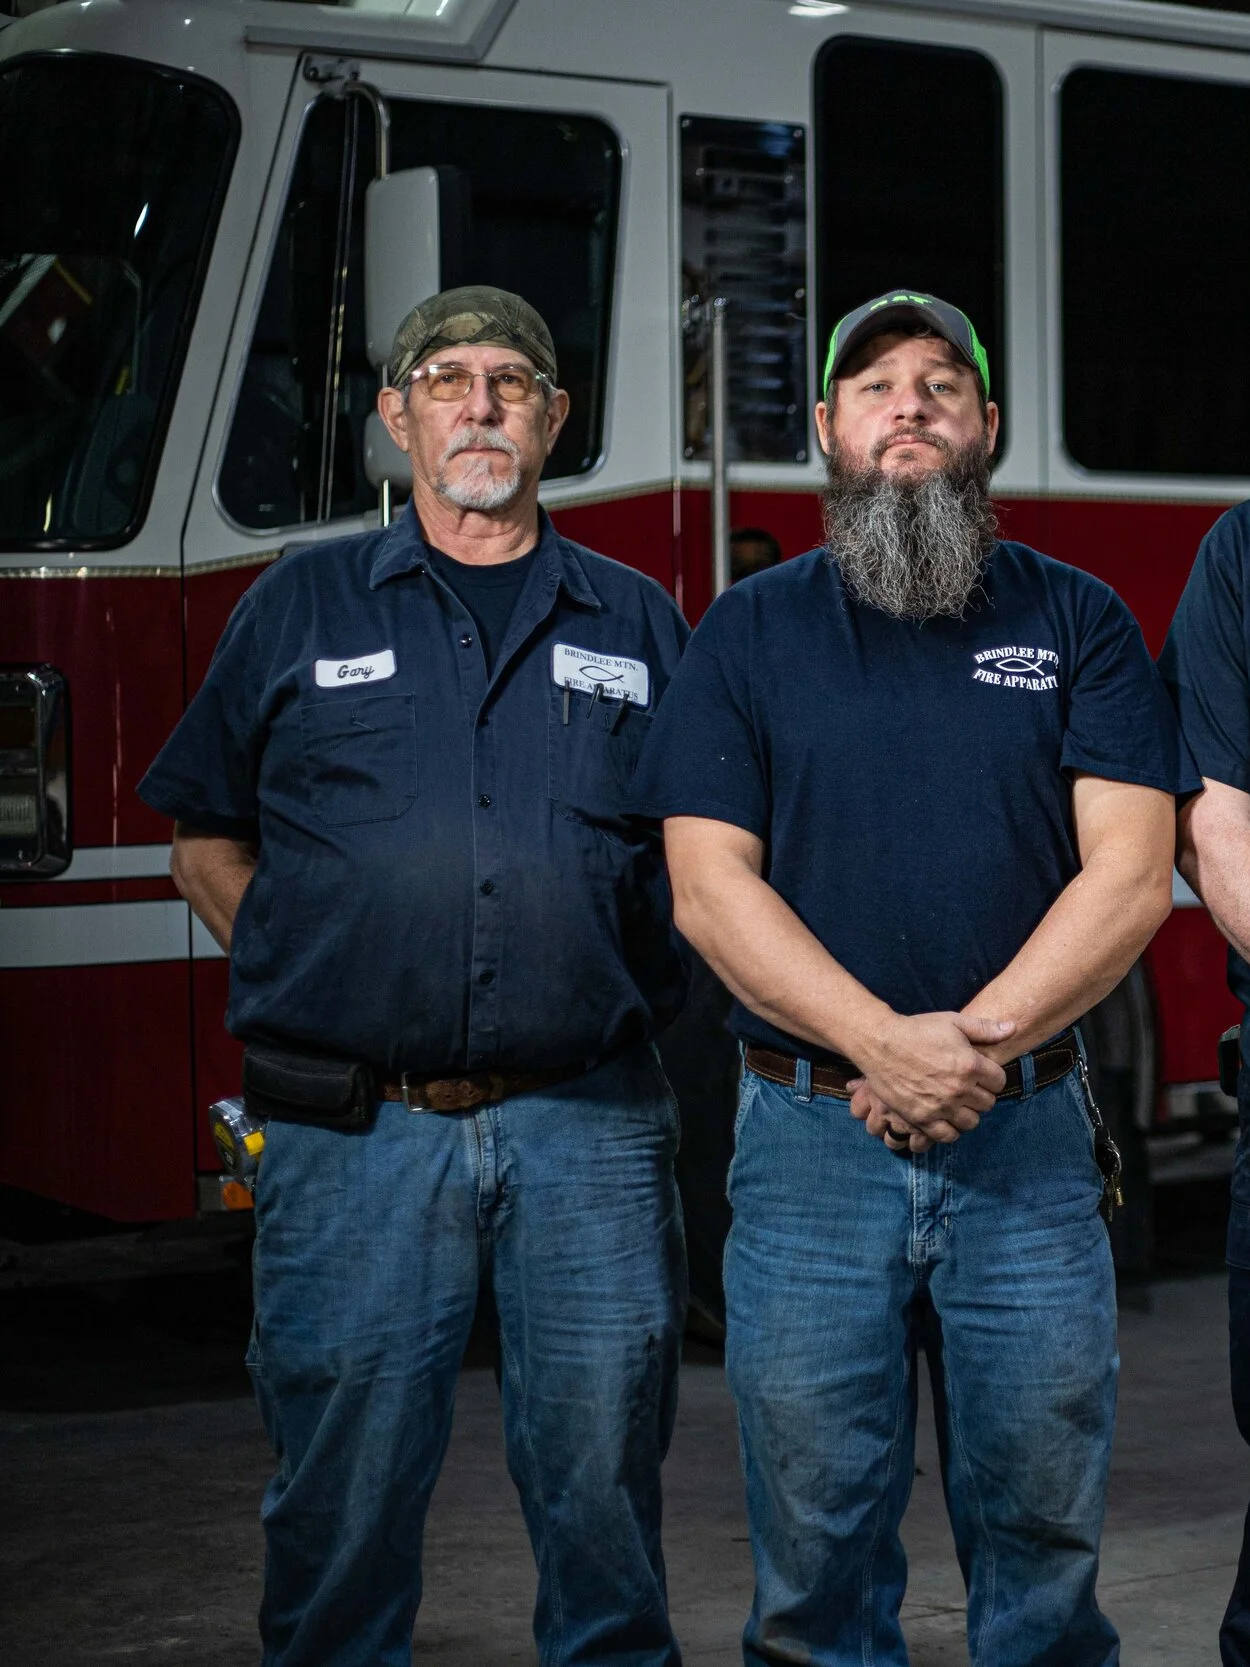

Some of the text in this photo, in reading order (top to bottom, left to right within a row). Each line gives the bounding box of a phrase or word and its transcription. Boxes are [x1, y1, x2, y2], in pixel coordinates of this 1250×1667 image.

[564, 648, 639, 671] BRINDLEE MTN.
[974, 646, 1035, 665] BRINDLEE
[337, 664, 375, 679] Gary
[972, 668, 1002, 685] FIRE
